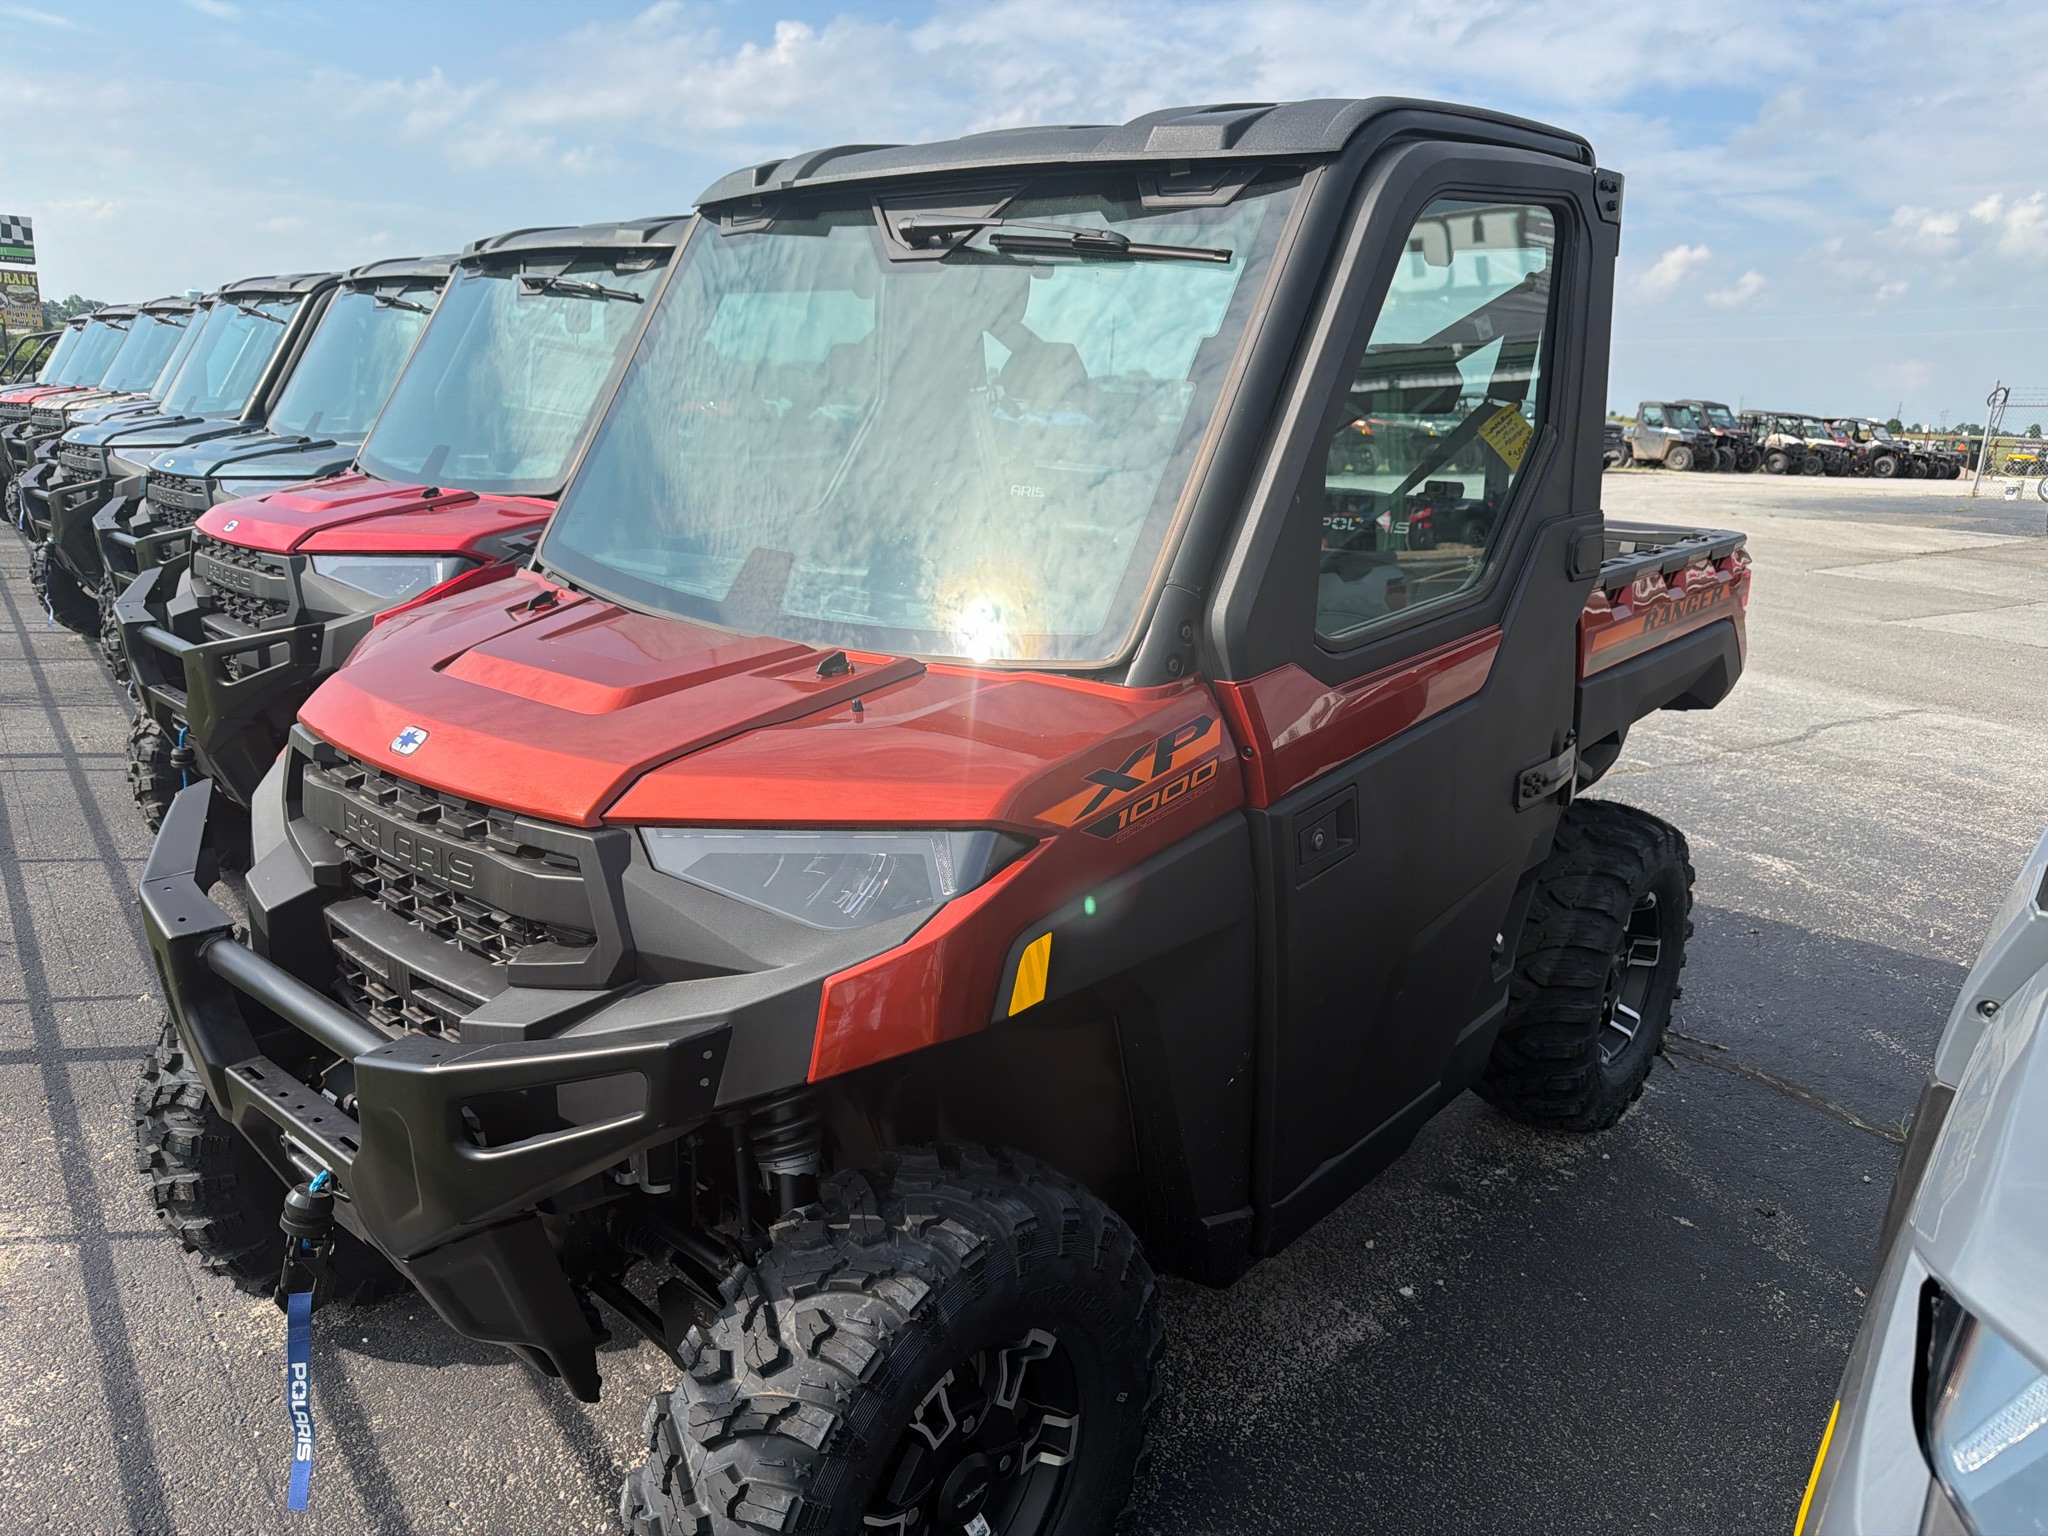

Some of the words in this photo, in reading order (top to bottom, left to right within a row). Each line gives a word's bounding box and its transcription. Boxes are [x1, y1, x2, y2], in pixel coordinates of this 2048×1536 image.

[7, 310, 28, 318] Right
[1322, 517, 1410, 534] POLIS
[1642, 583, 1724, 635] RANGER
[1072, 714, 1214, 823] XP
[1118, 759, 1218, 830] 1000
[344, 802, 476, 889] POLARIS
[291, 1362, 311, 1462] POLARIS
